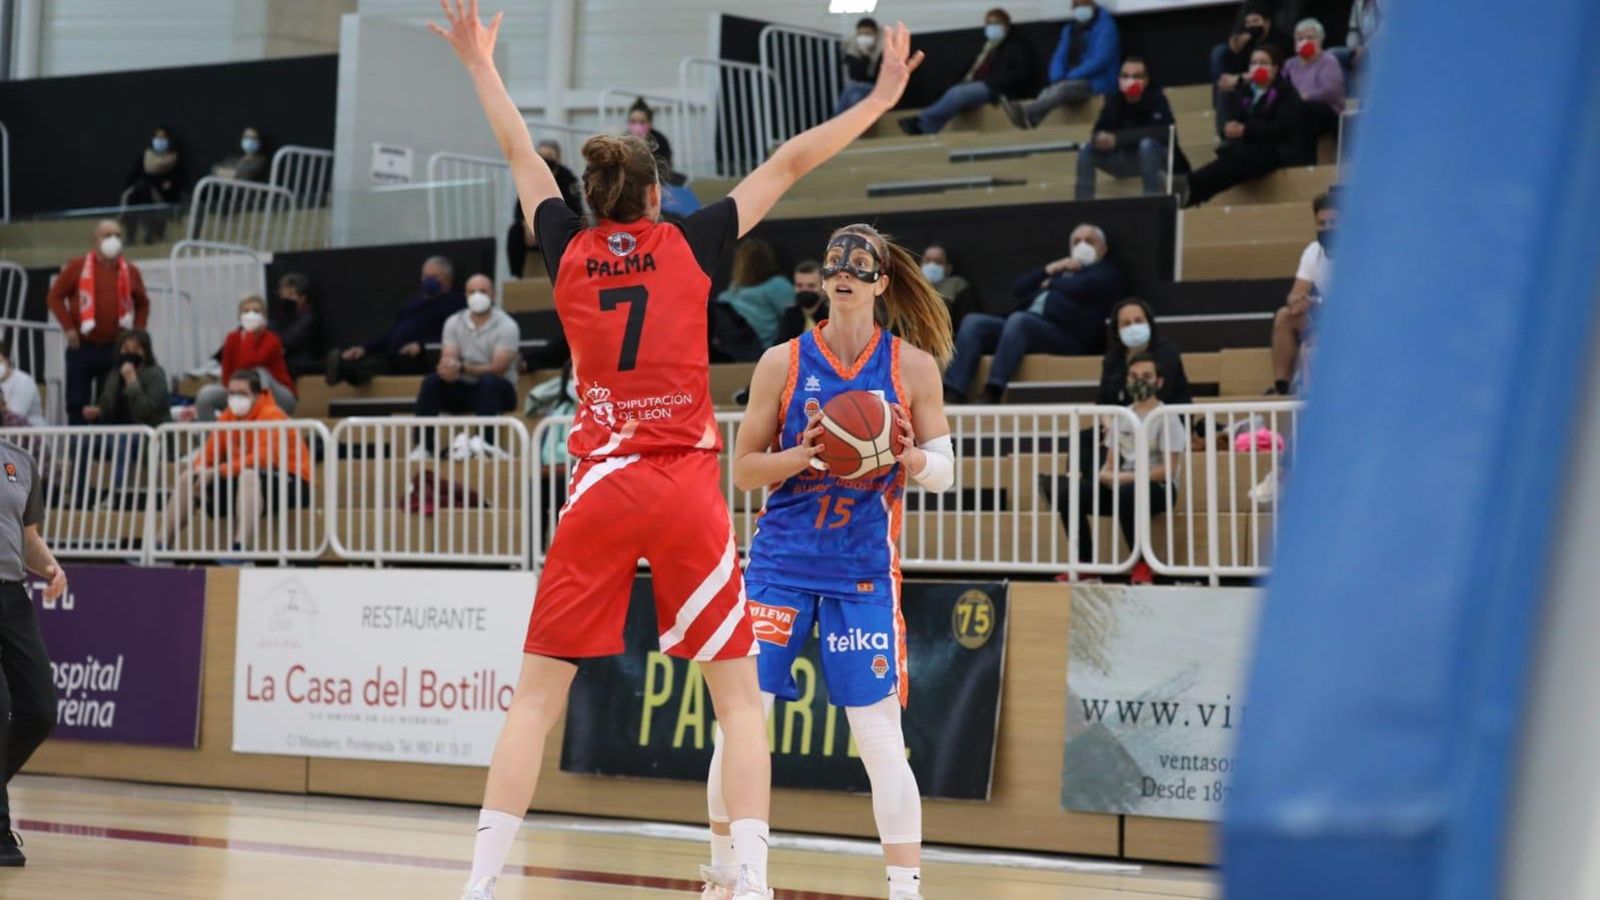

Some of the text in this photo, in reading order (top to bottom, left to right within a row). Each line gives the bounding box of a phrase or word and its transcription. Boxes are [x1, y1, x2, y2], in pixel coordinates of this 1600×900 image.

[586, 252, 656, 278] PALMA
[598, 284, 649, 372] 7
[617, 392, 692, 410] DIPUTACIÓN
[618, 406, 671, 421] DE LEÓN
[814, 494, 855, 529] 15
[361, 605, 487, 631] RESTAURANTE
[750, 605, 791, 624] ULEVA
[957, 603, 990, 634] 75
[827, 628, 889, 653] teika
[246, 664, 515, 712] La Casa del Botillo
[1081, 693, 1247, 729] www.vi
[1141, 776, 1197, 801] Desde
